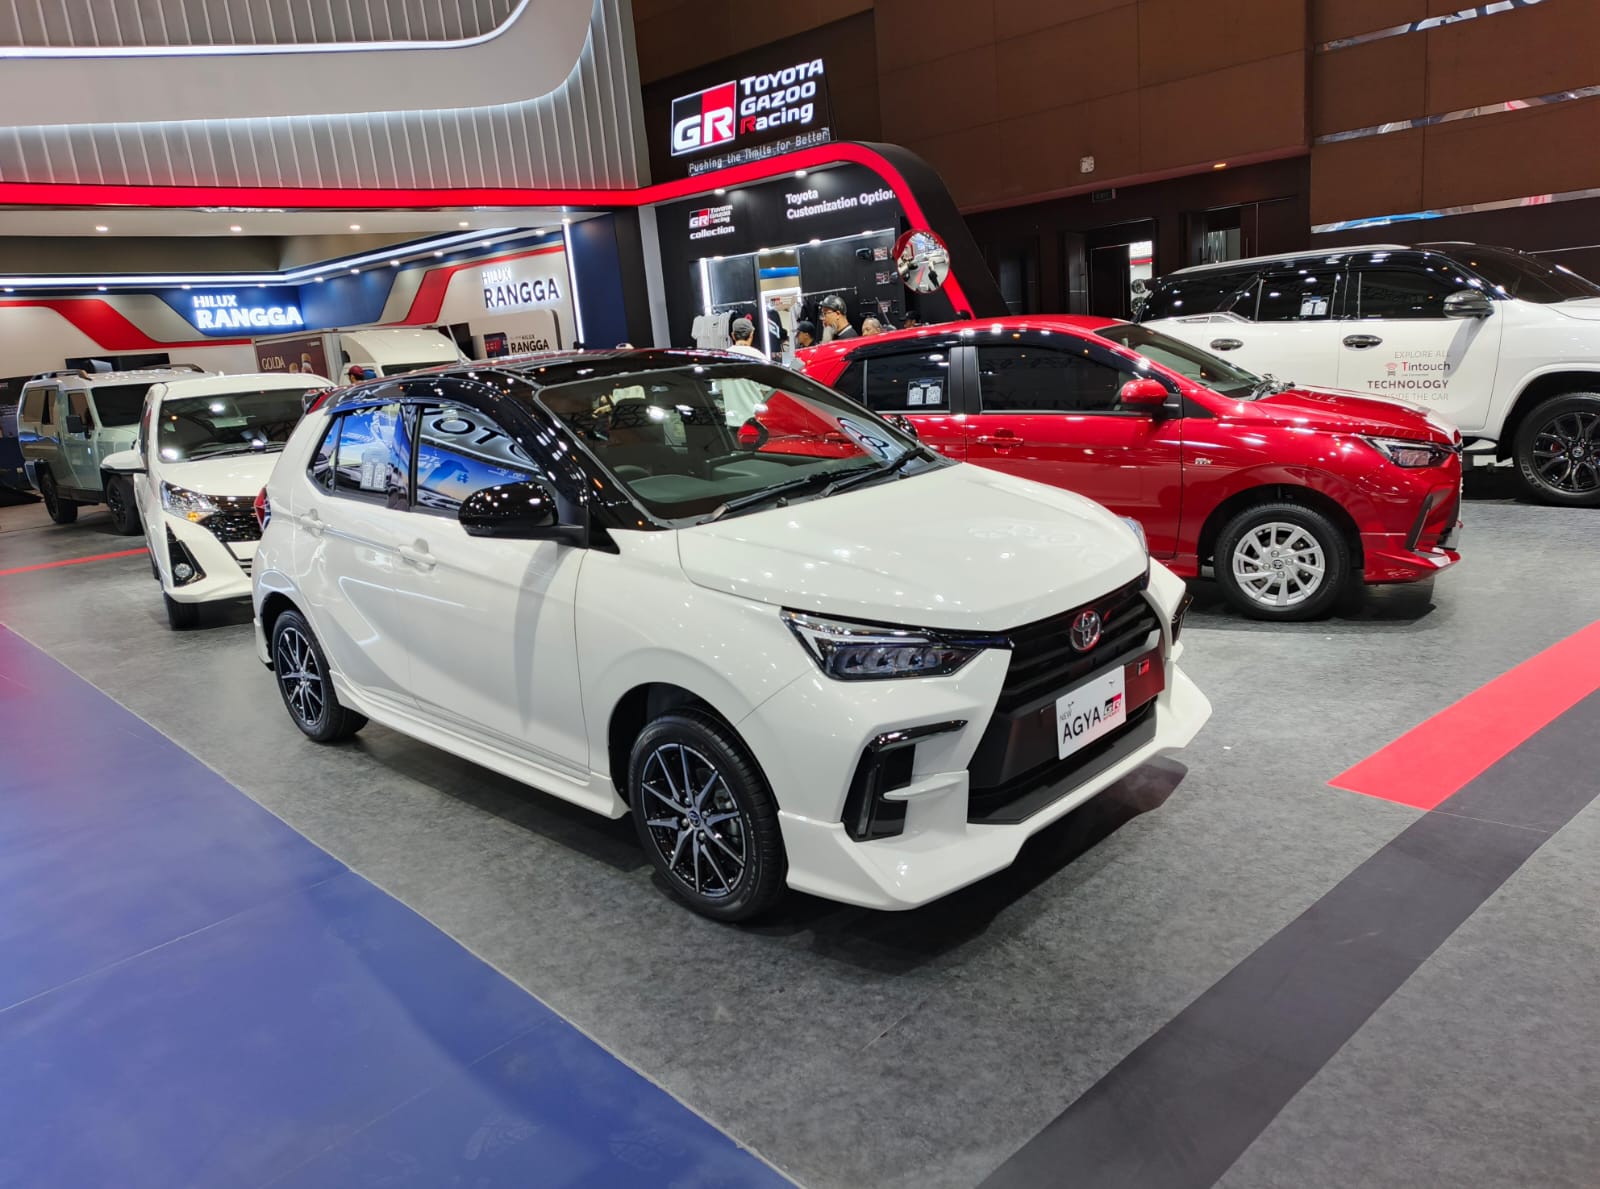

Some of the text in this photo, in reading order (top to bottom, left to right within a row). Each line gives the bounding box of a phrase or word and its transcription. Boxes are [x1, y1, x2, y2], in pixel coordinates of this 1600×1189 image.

[740, 58, 824, 95] TOYOTA
[740, 81, 816, 116] GAZOO
[740, 103, 814, 134] Racing
[673, 106, 733, 150] GR
[689, 158, 722, 173] Pushing
[727, 153, 741, 163] the
[776, 141, 791, 152] for
[795, 131, 829, 147] Better
[785, 189, 819, 205] Toyota
[786, 195, 858, 219] Customization
[689, 216, 709, 229] GR
[689, 226, 735, 240] collection
[482, 267, 512, 285] HILUX
[193, 294, 238, 308] HILUX
[484, 278, 560, 308] RANGGA
[195, 306, 304, 329] RANGGA
[510, 339, 550, 354] RANGGA
[1394, 350, 1433, 359] EXPLORE
[261, 356, 286, 370] GOLDA
[1401, 360, 1451, 371] Tintouch
[1367, 380, 1449, 389] TECHNOLOGY
[1411, 393, 1428, 401] THE
[1431, 393, 1449, 401] CAR
[1062, 706, 1102, 744] AGYA
